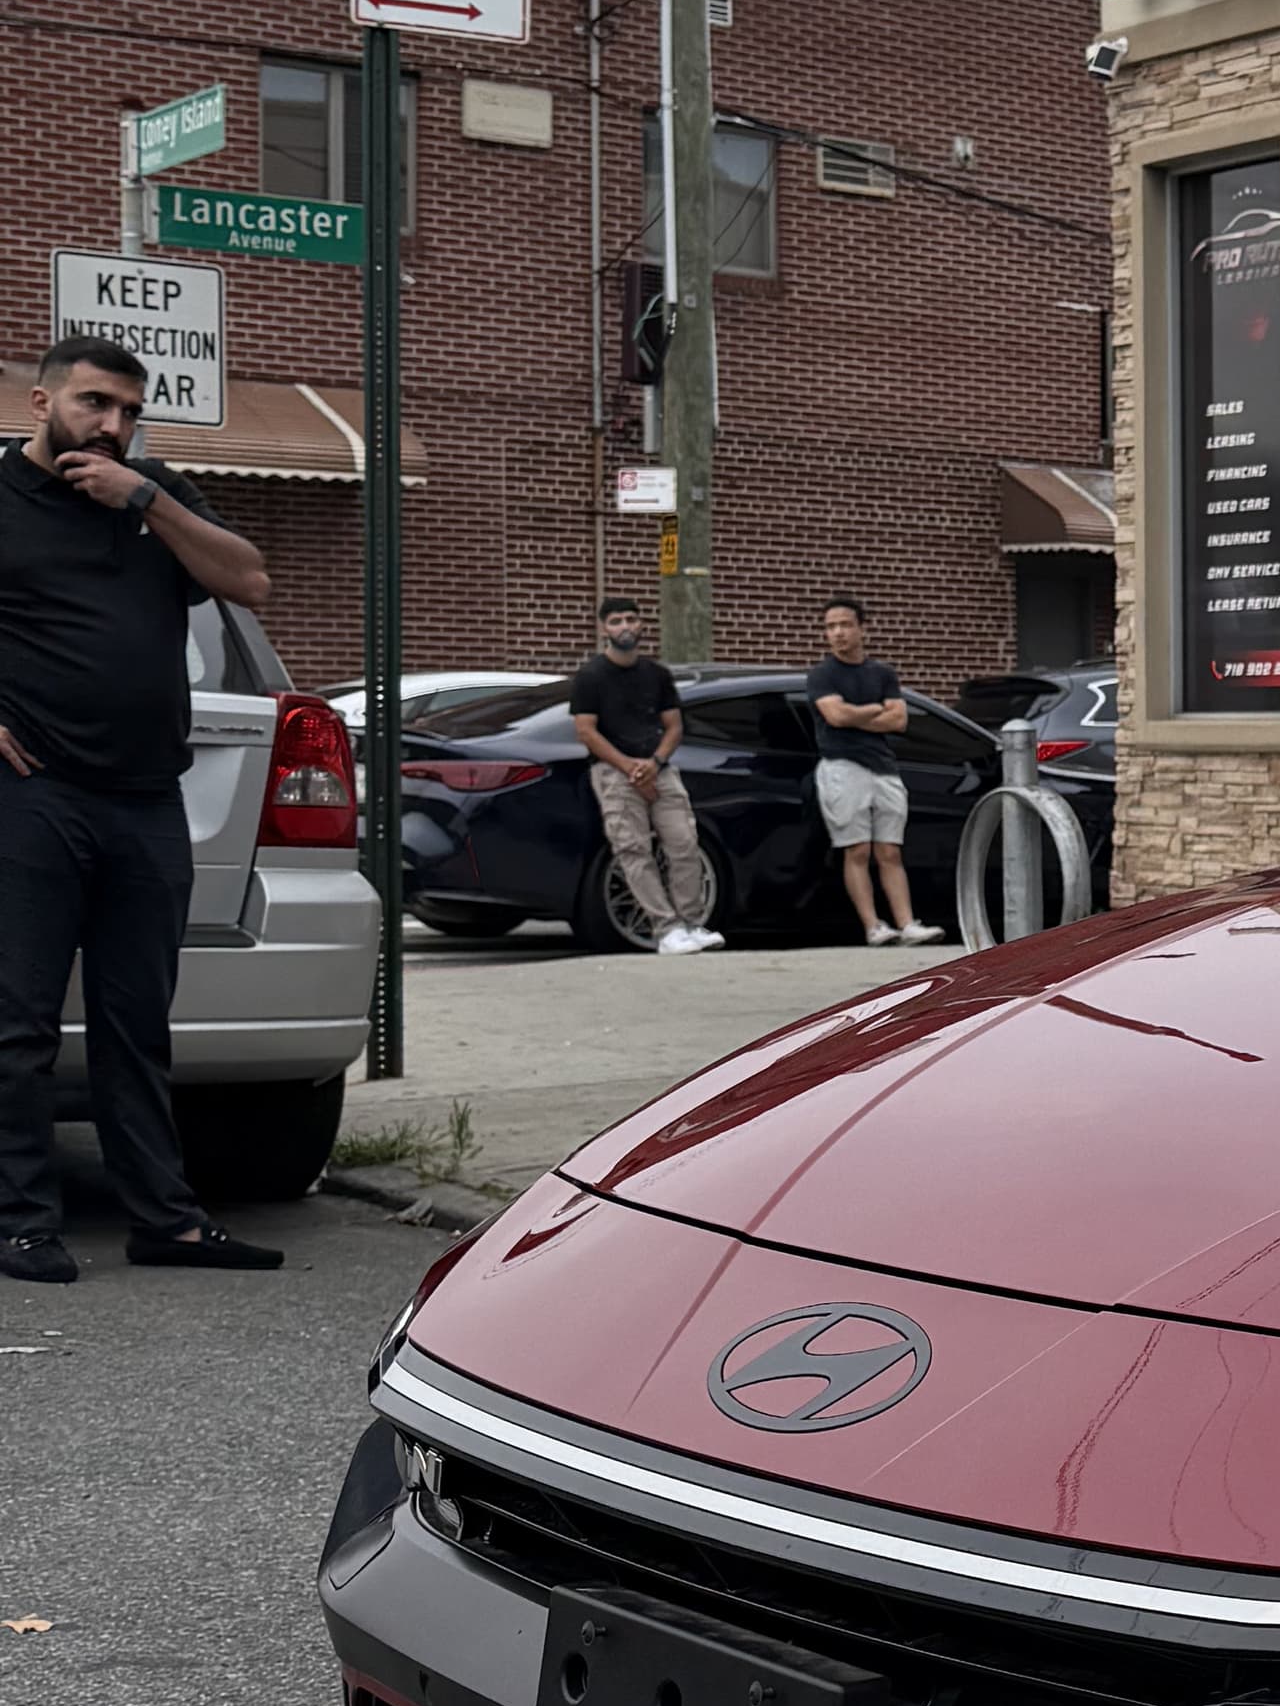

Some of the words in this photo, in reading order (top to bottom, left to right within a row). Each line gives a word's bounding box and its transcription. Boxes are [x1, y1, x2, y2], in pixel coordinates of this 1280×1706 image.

[141, 113, 177, 149] Coney
[181, 96, 221, 134] Island
[173, 192, 349, 240] Lancaster
[228, 230, 297, 253] Avenue
[97, 272, 182, 312] KEEP
[1206, 400, 1244, 417] SALES
[1206, 432, 1255, 449] LEASING
[1206, 464, 1267, 482] FINANCING
[1207, 500, 1238, 514] USED
[1238, 497, 1270, 511] CARS
[1207, 530, 1271, 547] INSURANCE
[1232, 563, 1280, 578] SERVICE
[1207, 598, 1245, 612] LEASE
[1224, 662, 1244, 676] 718
